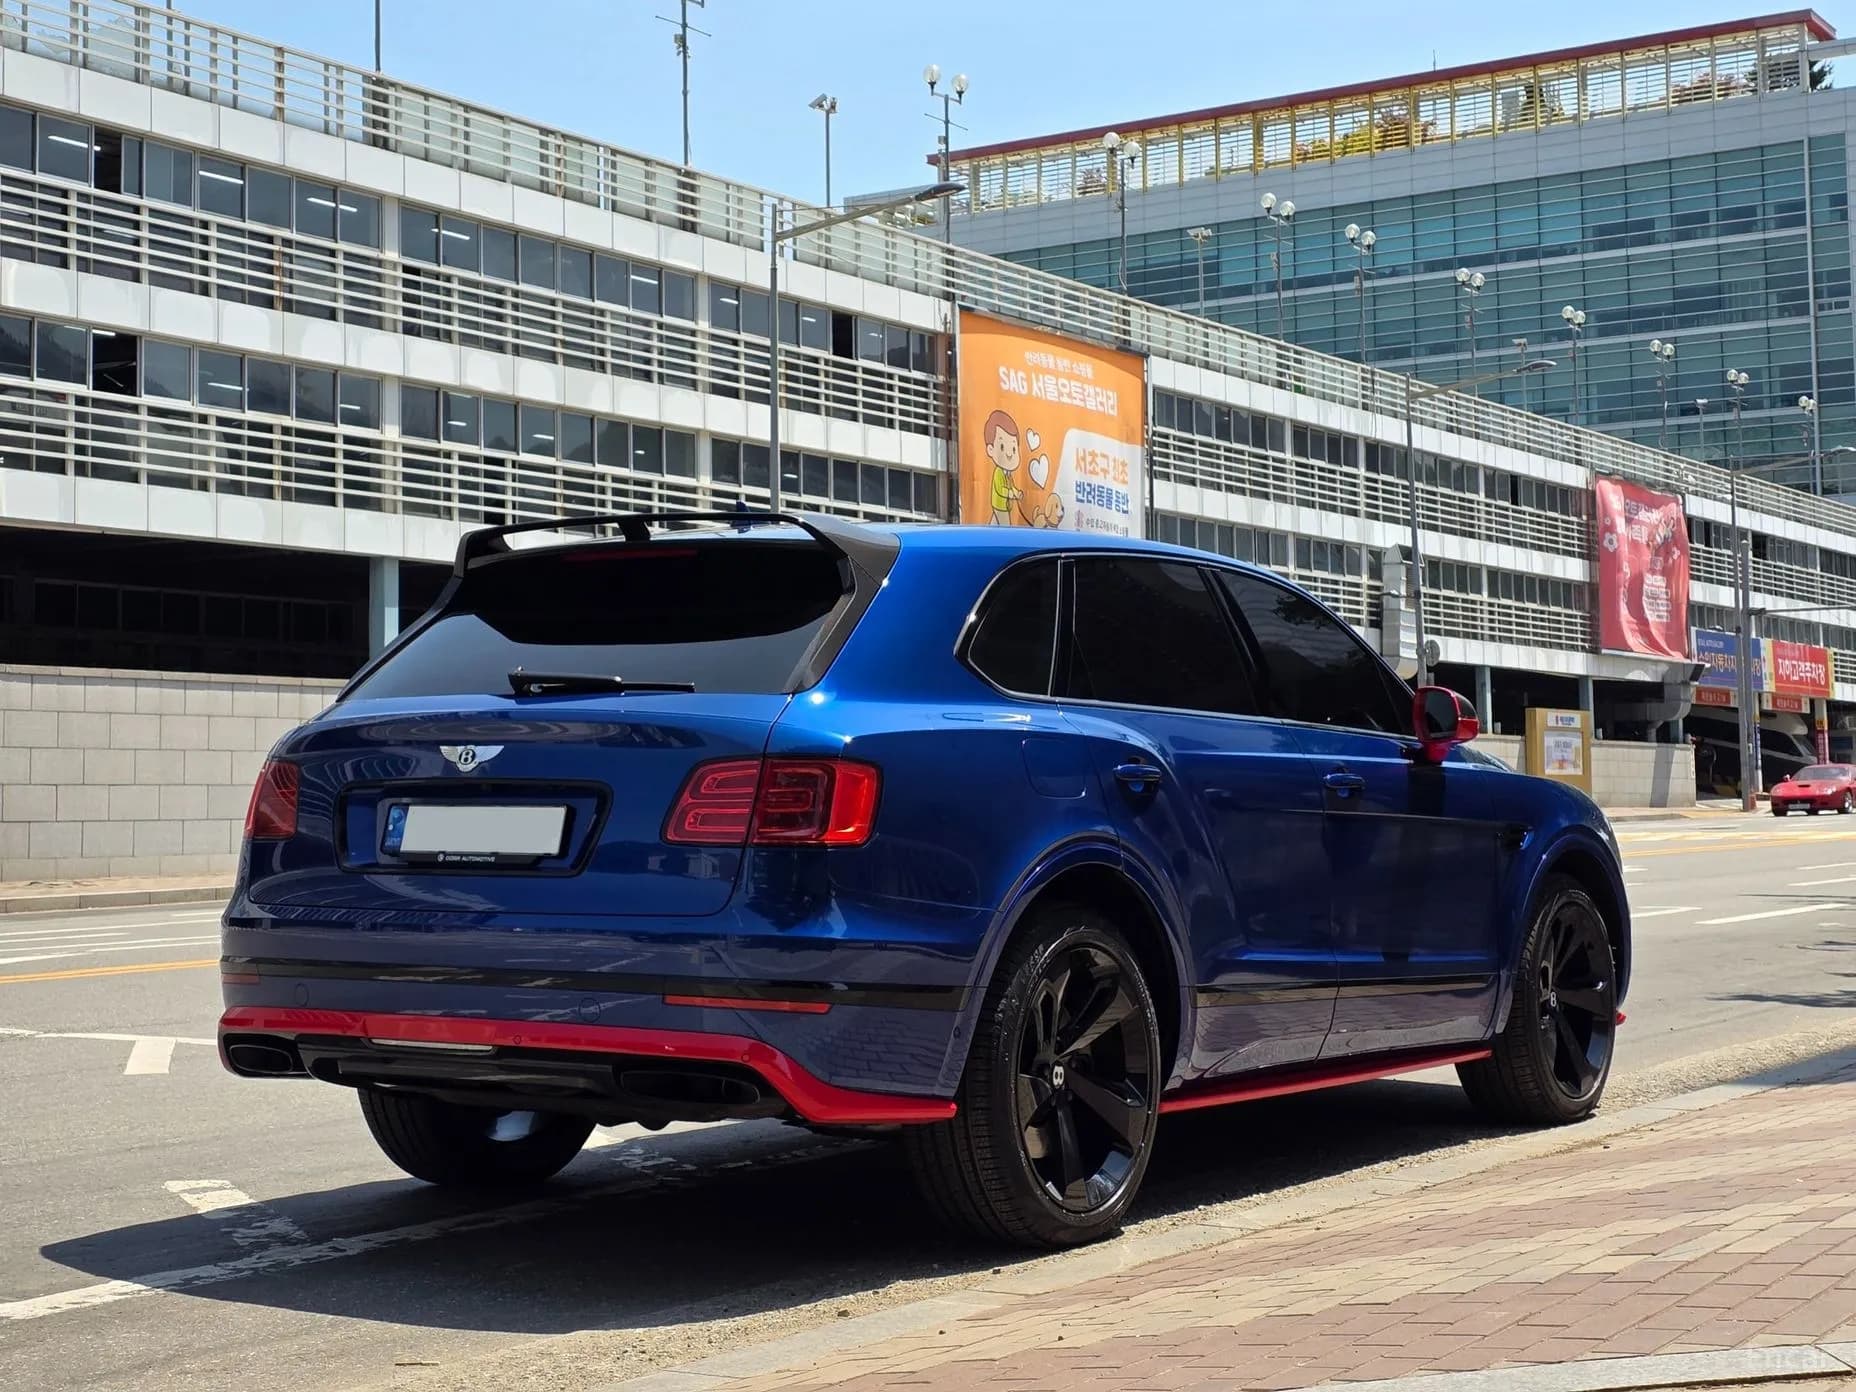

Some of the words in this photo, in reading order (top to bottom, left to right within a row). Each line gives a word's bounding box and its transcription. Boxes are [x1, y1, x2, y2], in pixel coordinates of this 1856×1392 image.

[998, 366, 1028, 396] SAG
[1031, 372, 1118, 417] 서울오토갤러리
[1075, 447, 1109, 480] 서초구
[1075, 480, 1114, 511] 반려동물
[1115, 489, 1130, 515] 동반
[460, 748, 475, 765] B
